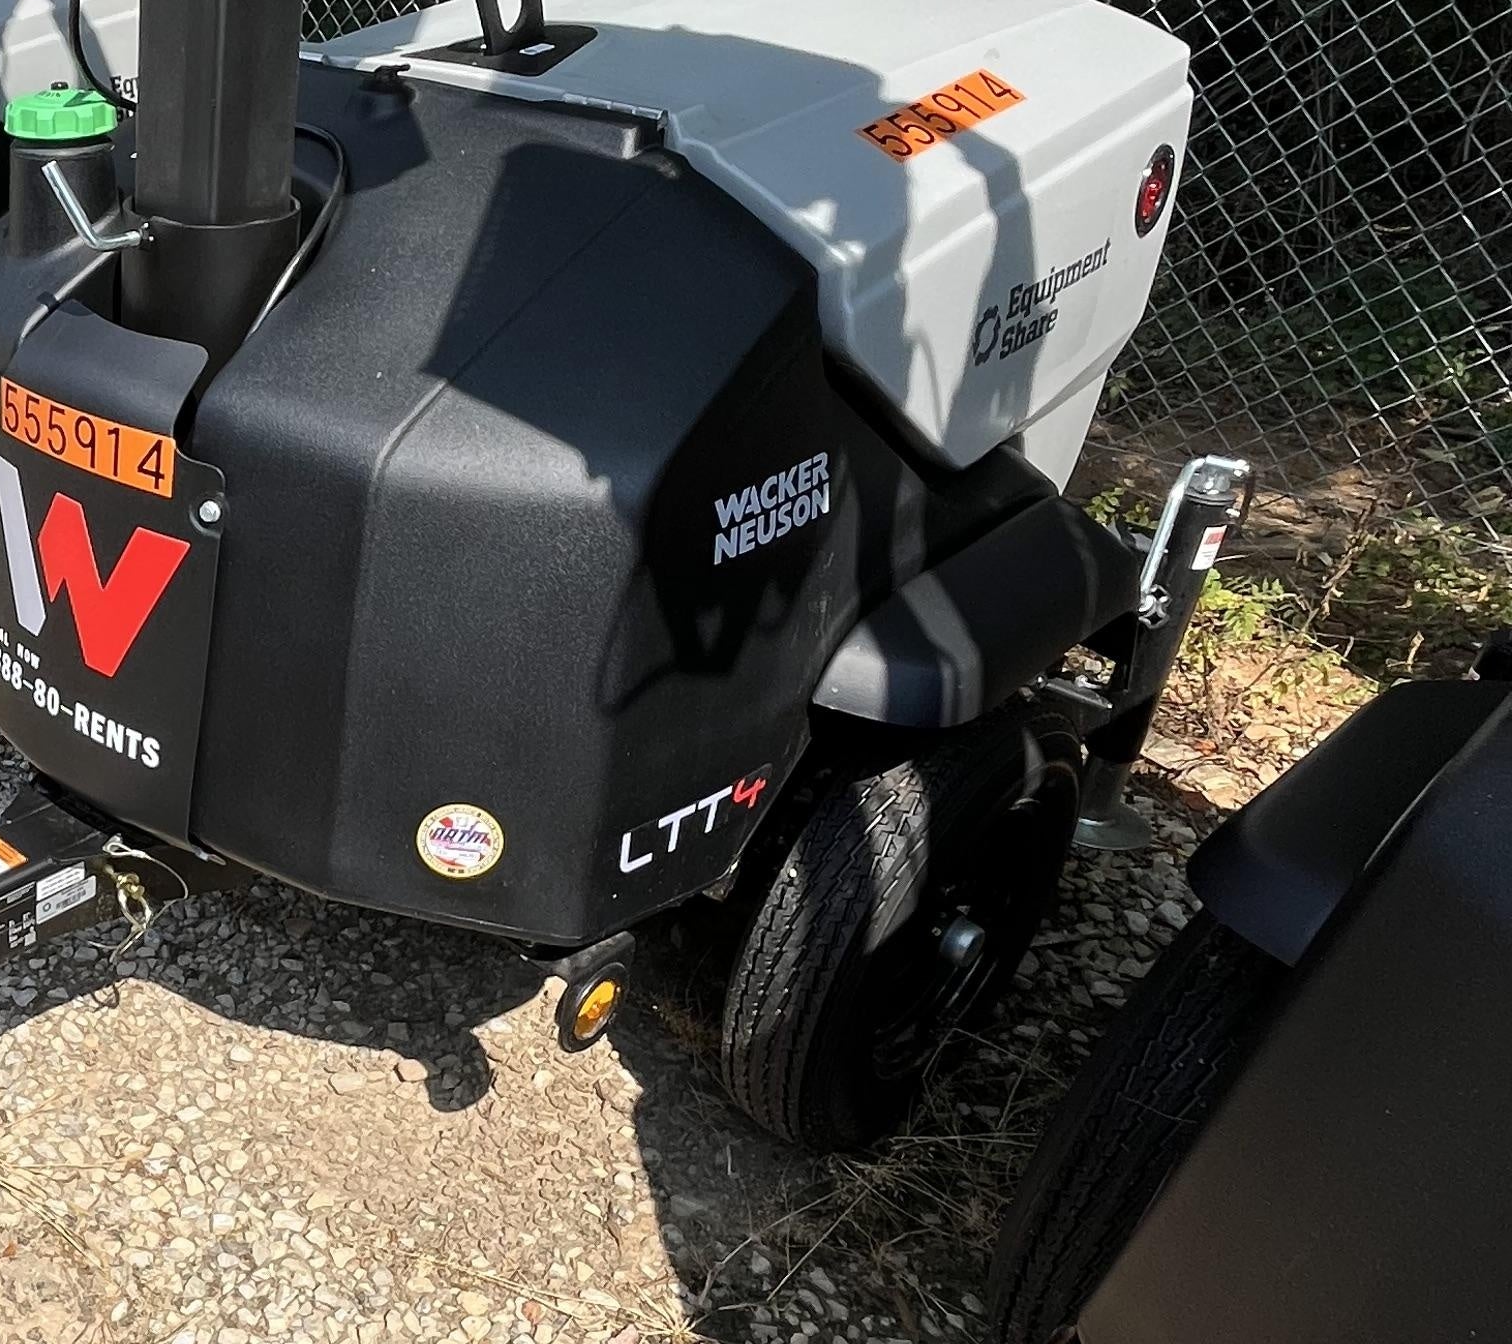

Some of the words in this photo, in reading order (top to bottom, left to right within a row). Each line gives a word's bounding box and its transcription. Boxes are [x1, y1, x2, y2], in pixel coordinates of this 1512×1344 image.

[863, 72, 1021, 157] 555914
[1006, 237, 1111, 321] Equipment
[999, 308, 1058, 360] Share
[3, 382, 165, 490] 555914
[714, 452, 829, 529] WACKER
[714, 482, 830, 566] NEUSON
[16, 642, 40, 669] NOW
[619, 775, 767, 874] LTT4
